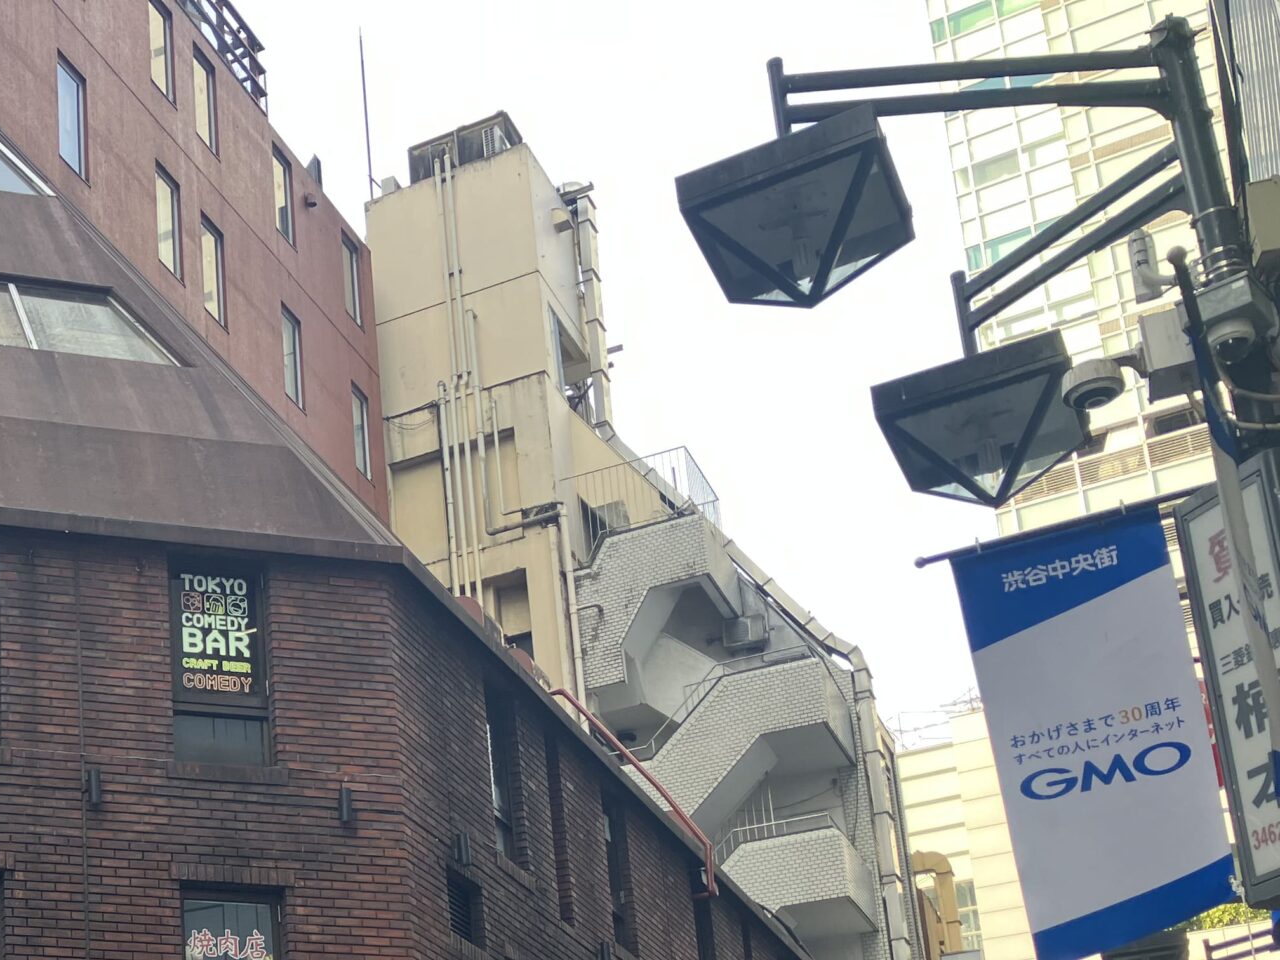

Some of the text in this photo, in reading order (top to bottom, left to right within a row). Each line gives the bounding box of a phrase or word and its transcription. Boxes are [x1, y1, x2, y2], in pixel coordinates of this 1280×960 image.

[180, 574, 247, 595] TOKYO
[1001, 545, 1118, 593] 渋谷中央街
[181, 612, 249, 631] COMEDY
[181, 627, 250, 658] BAR
[182, 658, 252, 673] CRAFT BEER
[182, 672, 252, 693] COMEDY
[1010, 697, 1182, 749] おかげさまで30周年
[1013, 716, 1185, 766] すべての人にインターネット
[1020, 741, 1192, 800] GMO
[187, 928, 267, 960] 焼肉店
